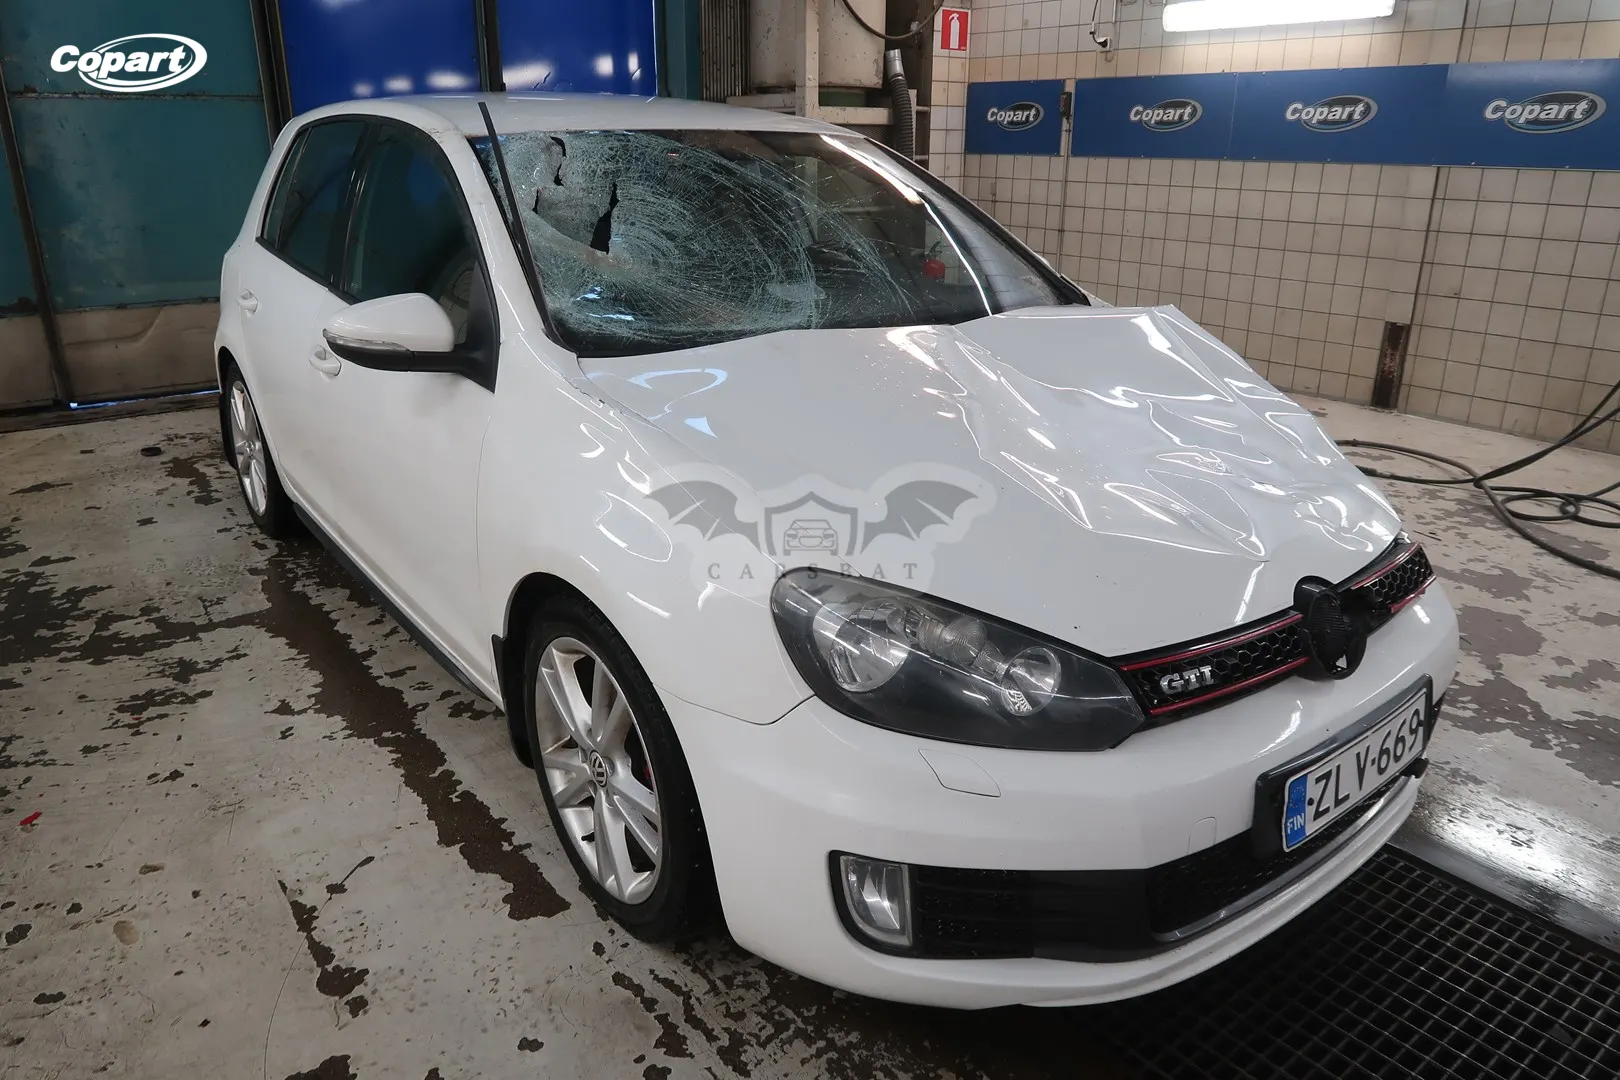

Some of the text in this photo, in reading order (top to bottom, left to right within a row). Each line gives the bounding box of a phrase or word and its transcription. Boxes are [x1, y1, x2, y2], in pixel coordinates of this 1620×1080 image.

[987, 107, 1037, 124] Copart
[1130, 103, 1194, 124] Copart
[1285, 99, 1368, 124] Copart
[1484, 97, 1593, 124] Copart
[1160, 665, 1214, 694] GTI
[1286, 812, 1305, 834] FIN
